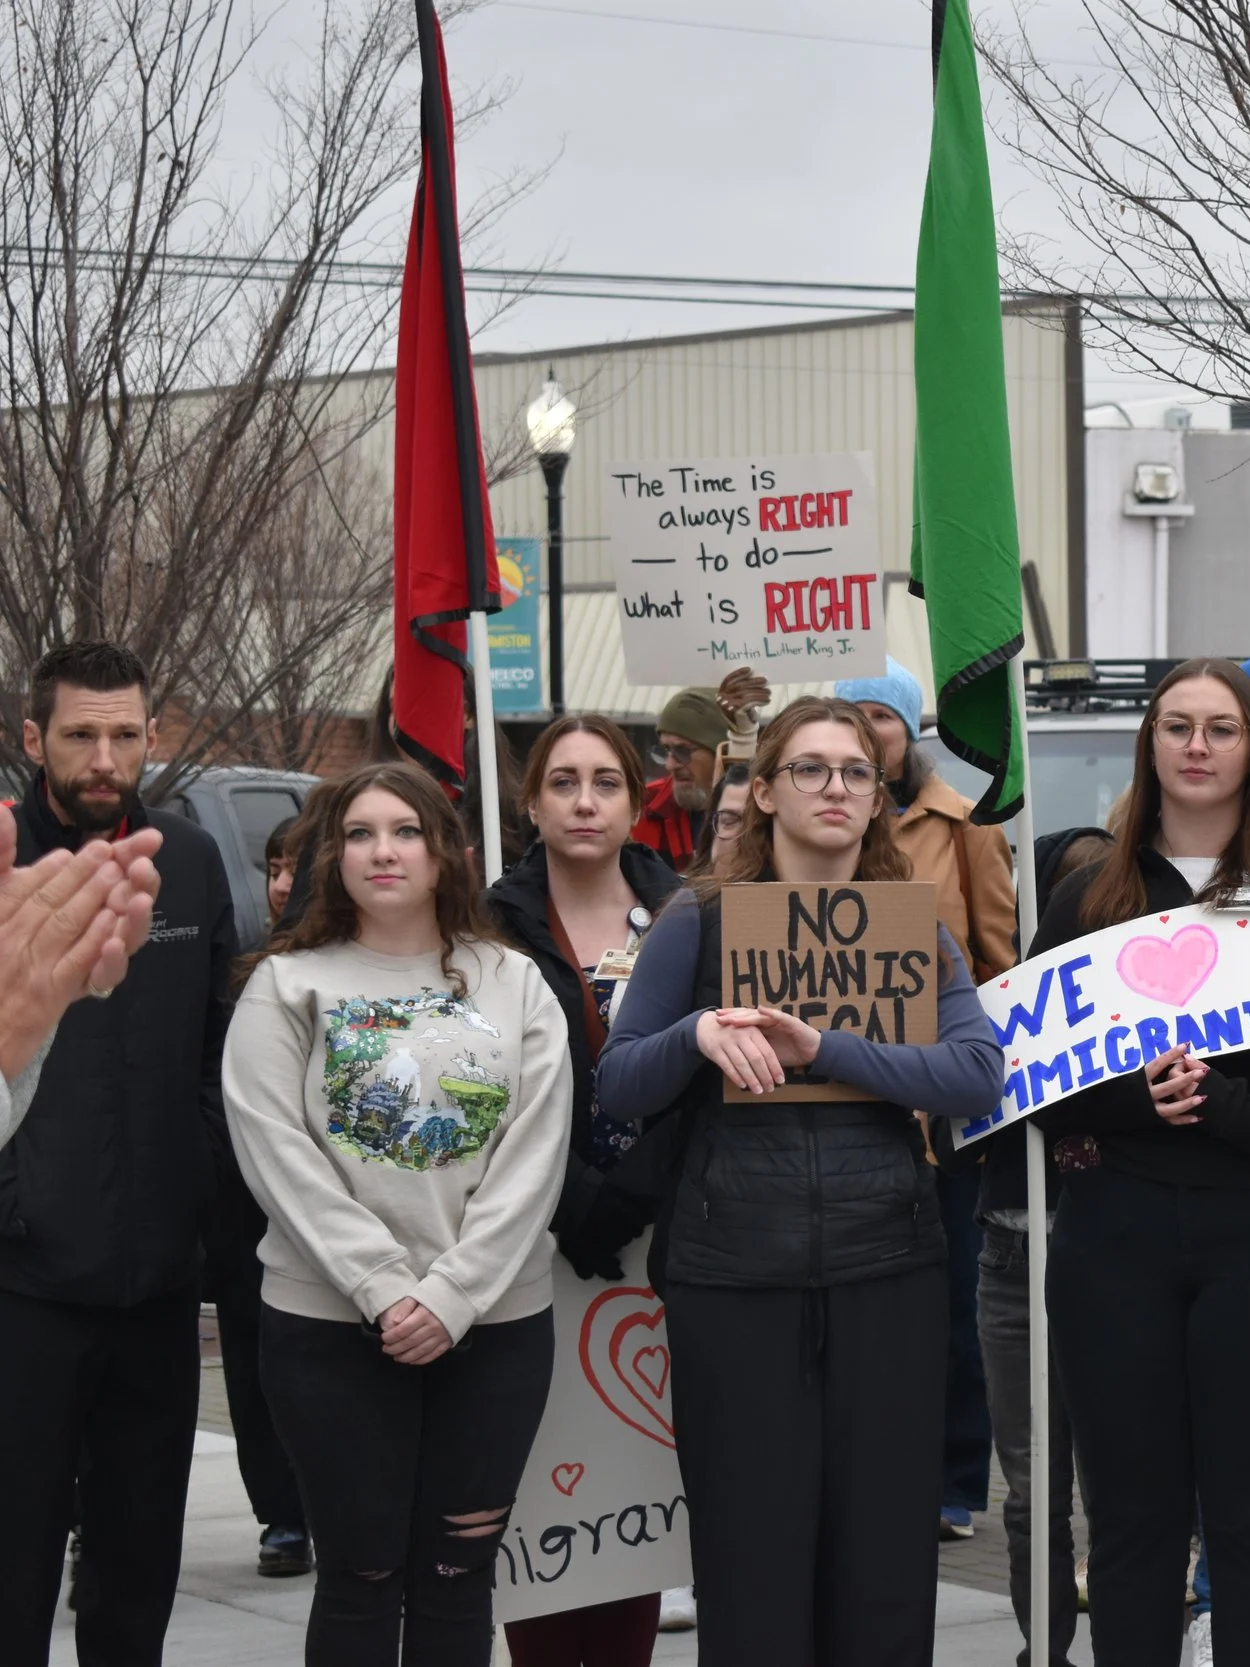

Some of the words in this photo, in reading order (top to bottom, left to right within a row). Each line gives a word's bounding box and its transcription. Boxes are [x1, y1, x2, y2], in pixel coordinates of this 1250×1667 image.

[612, 473, 664, 498] The
[669, 467, 736, 494] Time
[751, 465, 776, 490] is
[659, 505, 750, 534] always
[759, 490, 852, 532] RIGHT
[697, 542, 728, 572] to
[745, 538, 778, 568] do
[708, 593, 739, 624] is
[764, 573, 877, 633] RIGHT
[764, 637, 803, 658] Luther
[806, 636, 834, 657] King
[788, 888, 868, 950] NO
[731, 949, 867, 1008] HUMAN
[874, 951, 930, 998] IS
[987, 954, 1094, 1049] WE
